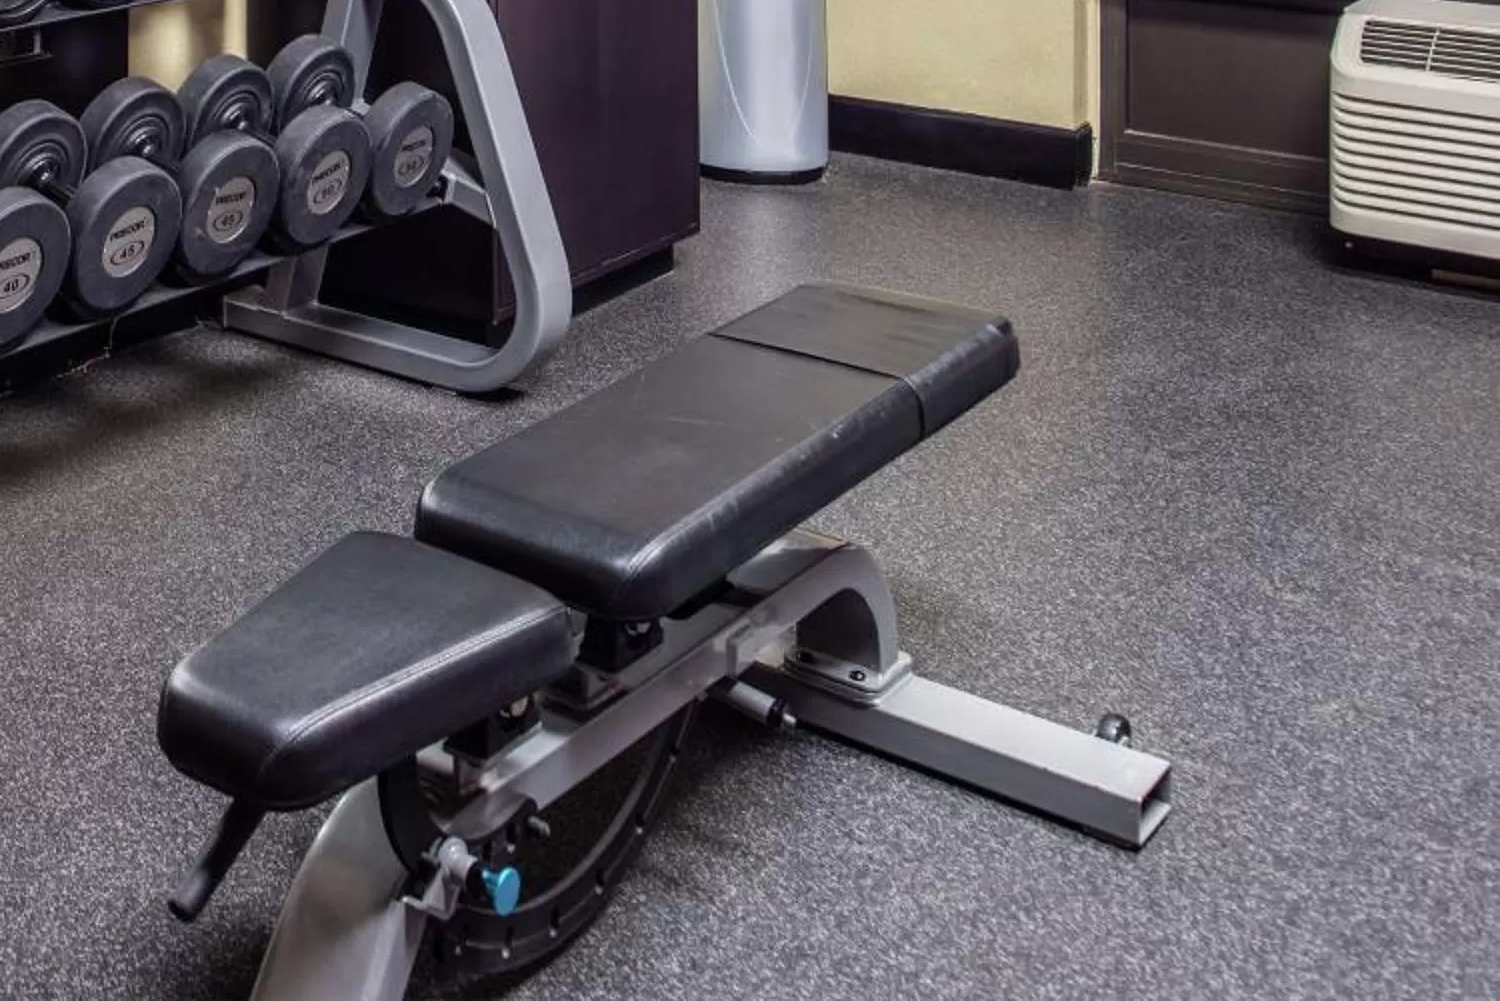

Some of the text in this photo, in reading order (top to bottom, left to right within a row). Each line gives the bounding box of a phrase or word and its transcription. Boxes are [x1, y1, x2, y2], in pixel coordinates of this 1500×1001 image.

[109, 220, 146, 242] PRECOR
[119, 245, 135, 260] 45
[3, 279, 20, 293] 40
